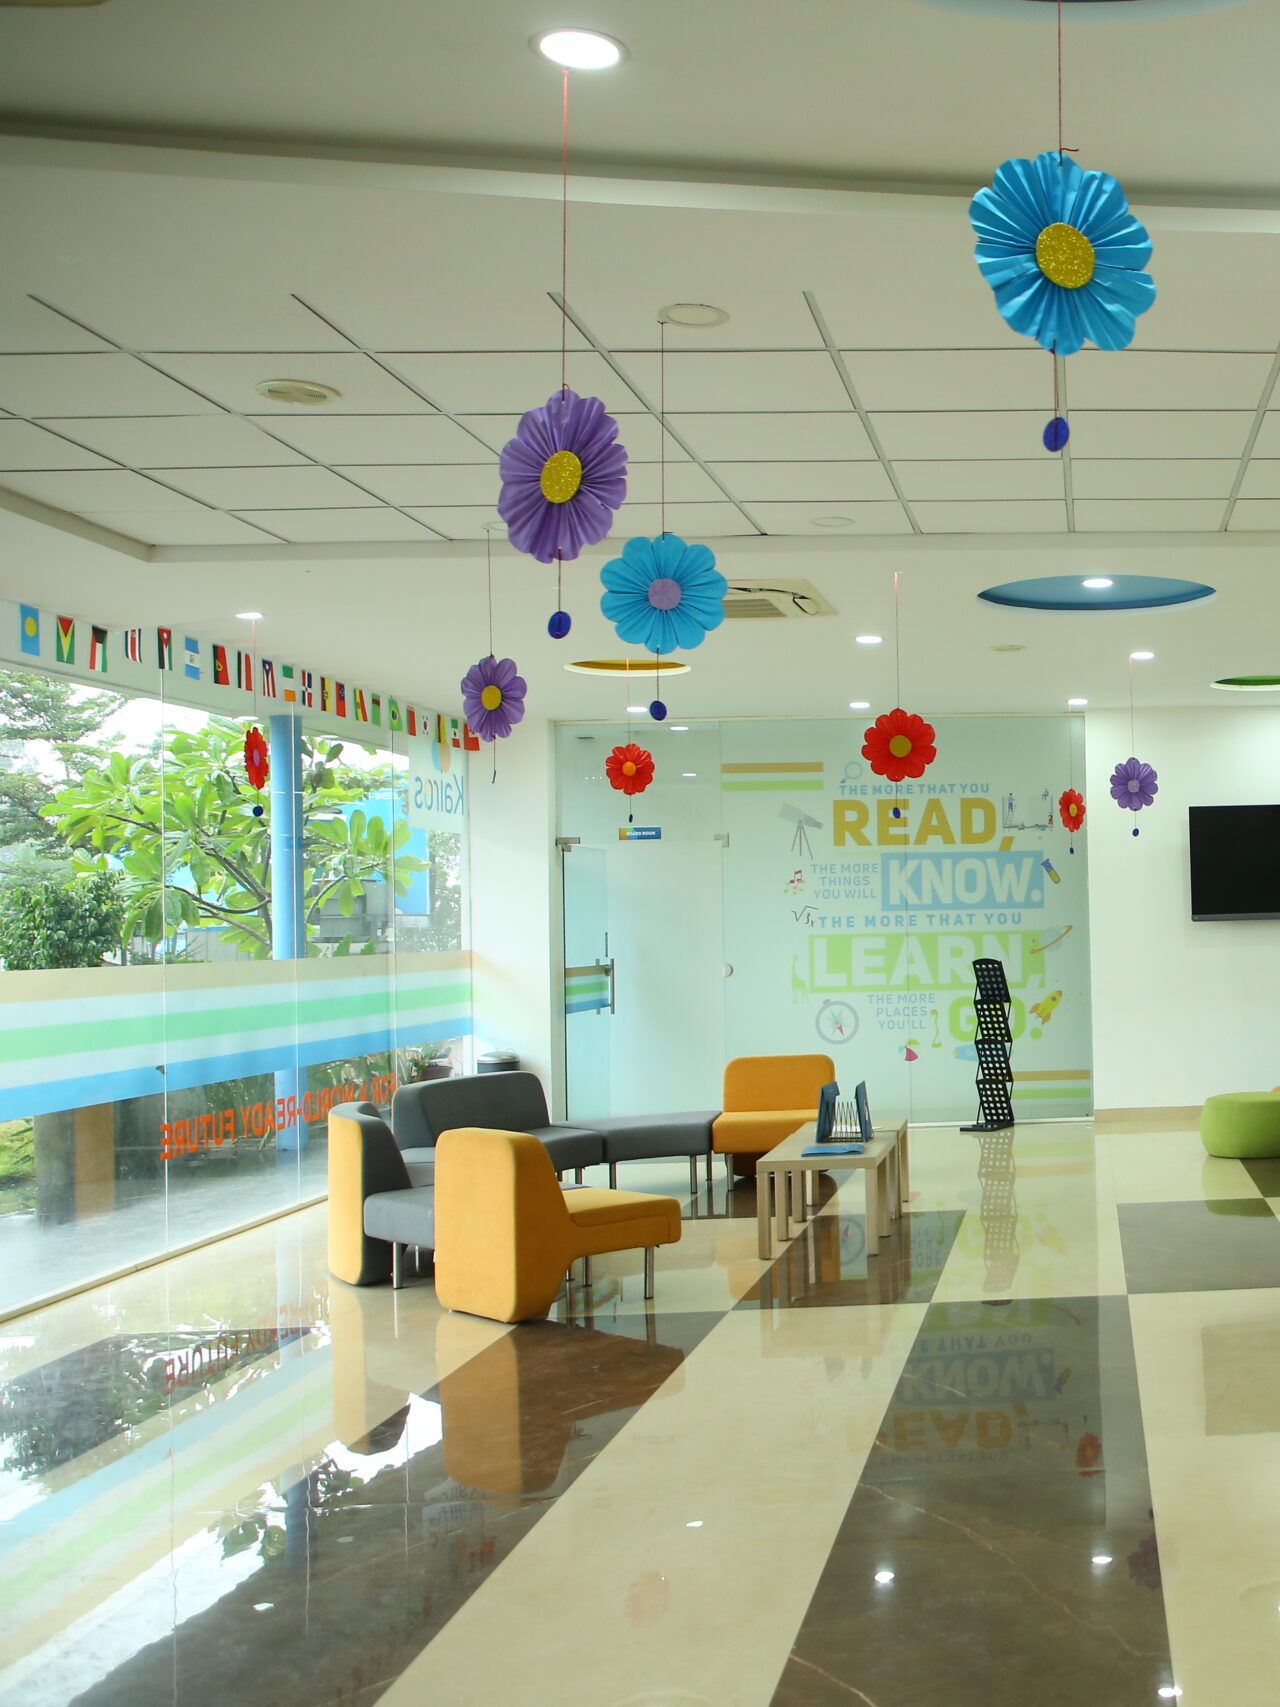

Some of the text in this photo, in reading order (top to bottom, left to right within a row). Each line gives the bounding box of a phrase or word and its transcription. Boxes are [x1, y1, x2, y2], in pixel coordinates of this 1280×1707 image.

[840, 783, 990, 795] THE MORE THAT YOU
[833, 797, 1015, 852] READ,
[811, 863, 879, 873] THE MORE
[820, 876, 871, 886] THINGS
[888, 857, 1043, 905] KNOW.
[814, 888, 877, 899] YOU WILL
[818, 912, 1022, 928] THE MORE THAT YOU
[867, 993, 936, 1004] THE MORE
[876, 1006, 928, 1017] PLACES
[878, 1019, 926, 1030] YOU'LL
